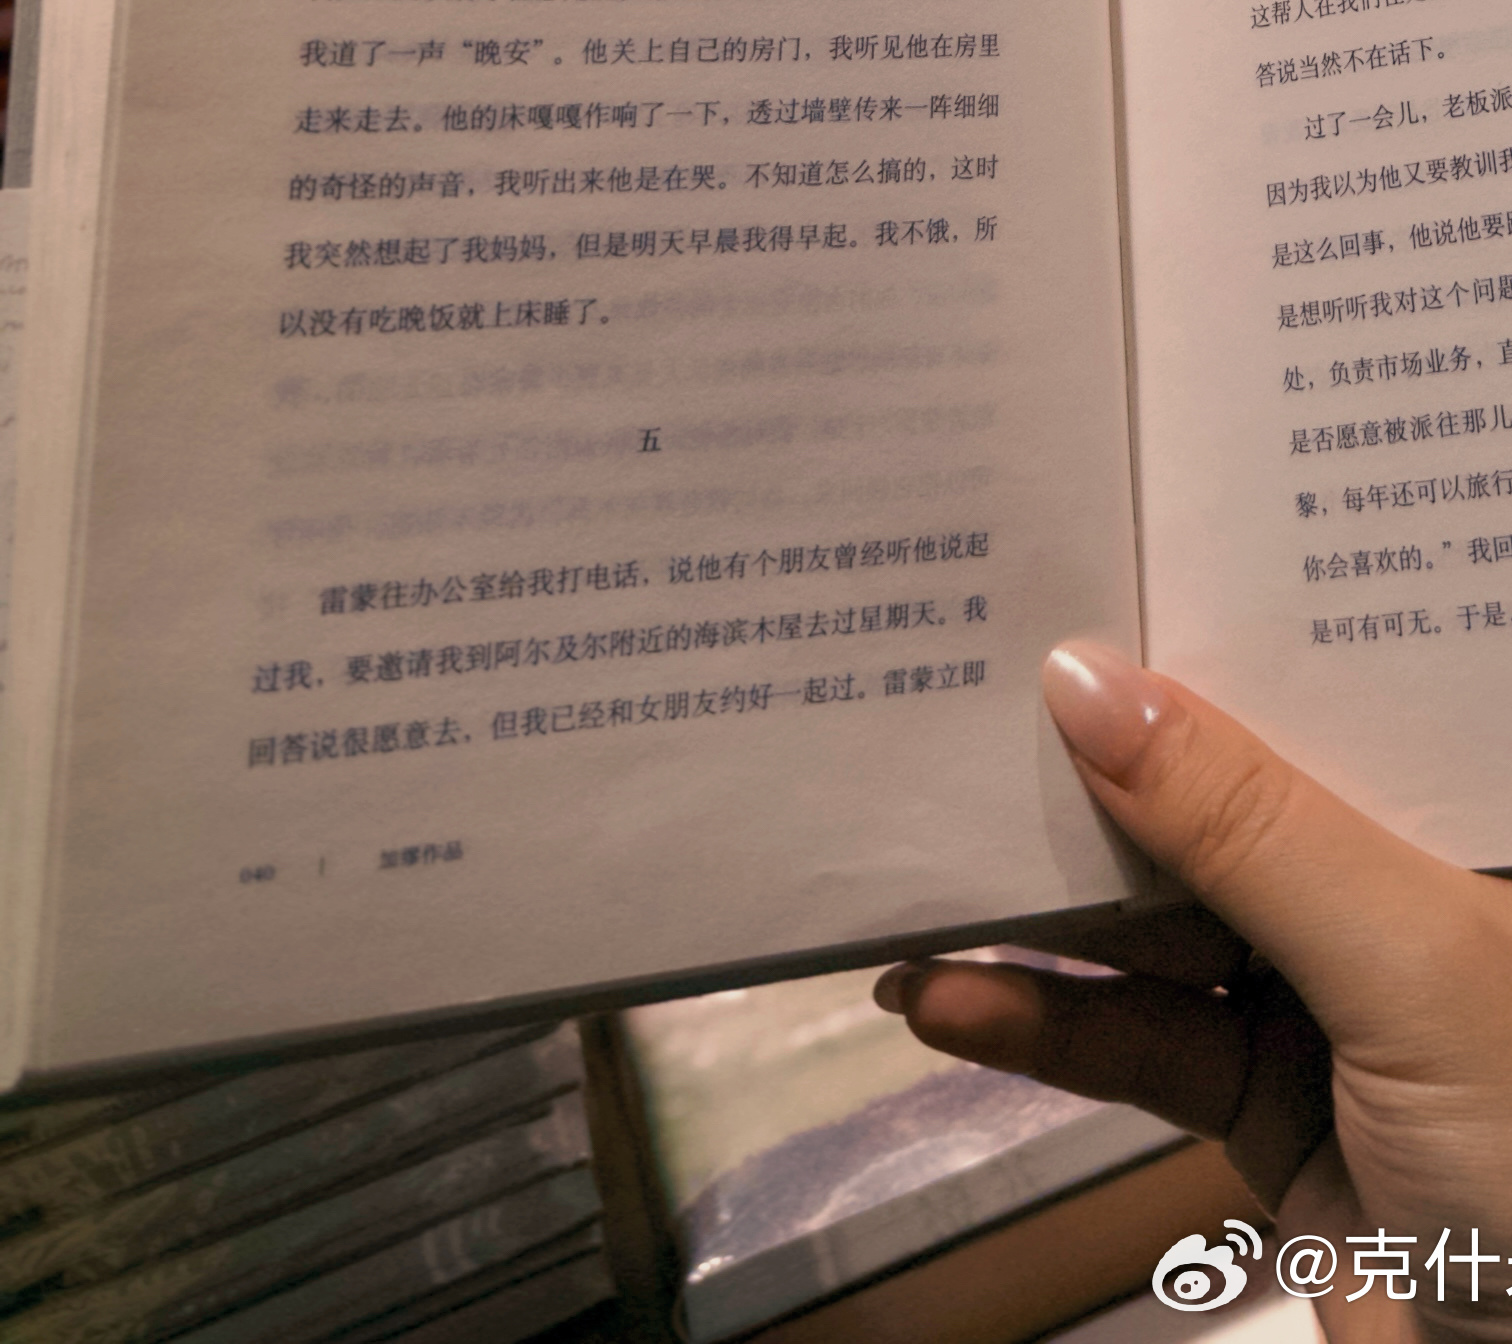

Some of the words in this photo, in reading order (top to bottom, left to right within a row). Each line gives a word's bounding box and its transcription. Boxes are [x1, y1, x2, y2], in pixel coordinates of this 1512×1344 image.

[299, 33, 1001, 67] 我道了一声“晚安”。他关上自己的房门，我听见他在房里
[1255, 36, 1448, 89] 答说当然不在话下。
[293, 93, 1000, 134] 走来走去。他的床嘎嘎作响了一下，透过墙壁传来一阵细细
[288, 154, 1000, 202] 的奇怪的声音，我听出来他是在哭。不知道怎么搞的，这时
[283, 215, 999, 271] 我突然想起了我妈妈，但是明天早晨我得早起。我不饿，所
[279, 298, 613, 339] 以没有吃晚饭就上床睡了。
[637, 426, 663, 453] 五
[318, 531, 990, 616] 雷蒙往办公室给我打电话，说他有个朋友曾经听他说起
[251, 595, 988, 694] 过我，要邀请我到阿尔及尔附近的海滨木屋去过星期天。我
[247, 659, 987, 769] 回答说很愿意去，但我已经和女朋友约好一起过。雷蒙立即
